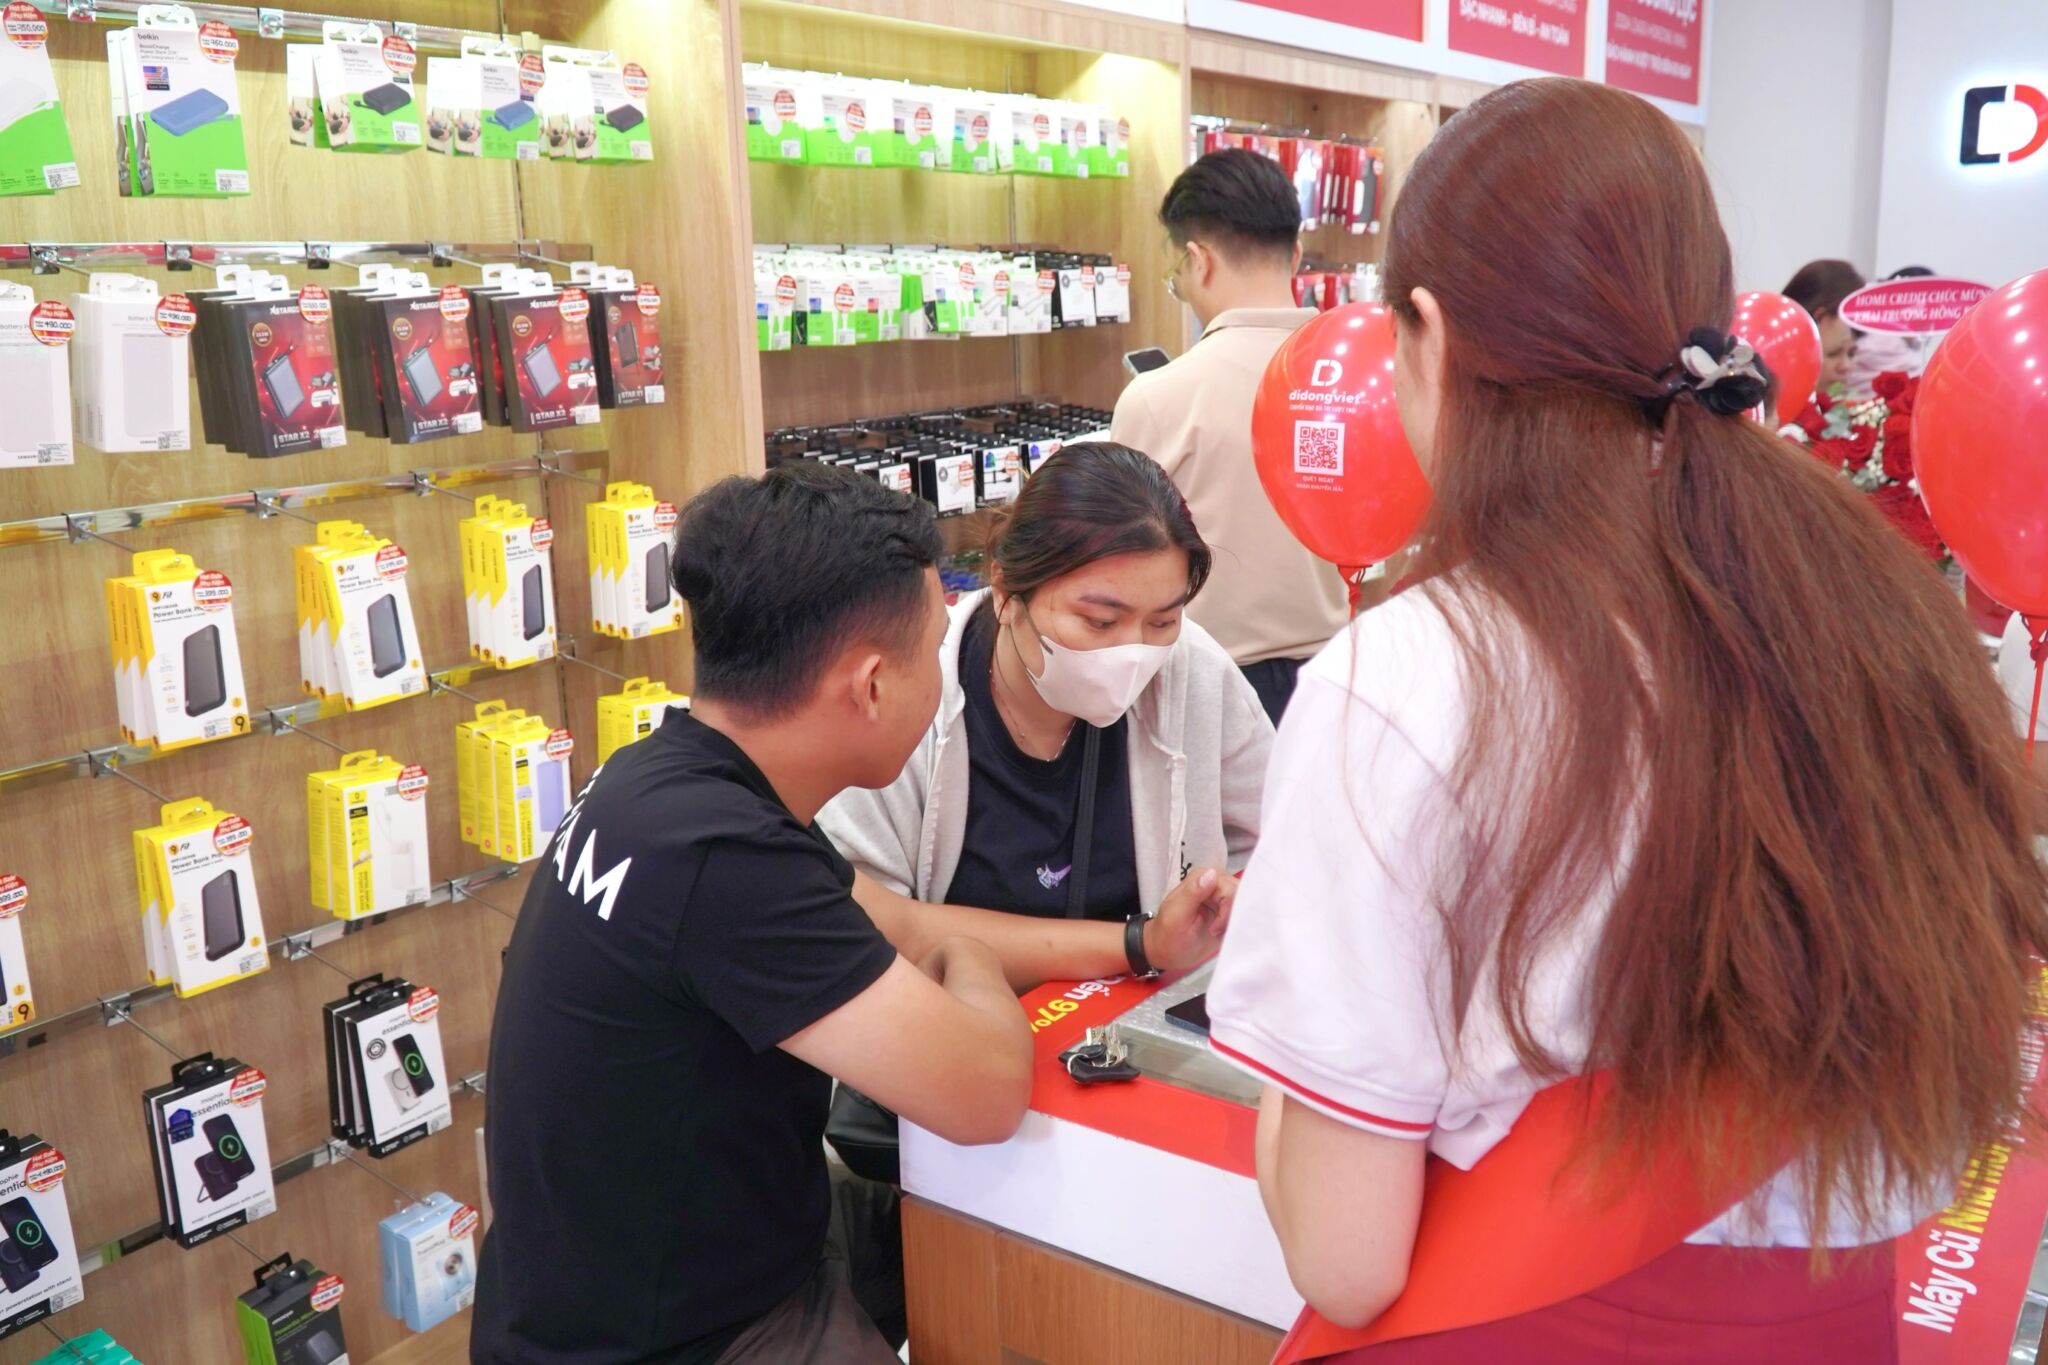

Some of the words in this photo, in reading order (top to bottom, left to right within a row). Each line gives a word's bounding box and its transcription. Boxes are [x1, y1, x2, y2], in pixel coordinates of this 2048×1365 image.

[138, 33, 159, 41] belkin
[1960, 286, 1991, 299] MỪN
[1289, 388, 1361, 404] didongviet
[535, 411, 555, 420] STAR
[418, 420, 437, 430] STAR
[279, 432, 299, 443] STAR
[153, 610, 174, 618] Power
[176, 607, 192, 615] Bank
[234, 716, 245, 732] 9
[17, 1004, 28, 1020] 9
[191, 1098, 231, 1118] essentia
[0, 1173, 19, 1184] ophie
[0, 1180, 26, 1197] entia
[1926, 1230, 1982, 1273] Cũ
[1903, 1268, 1977, 1334] Máy
